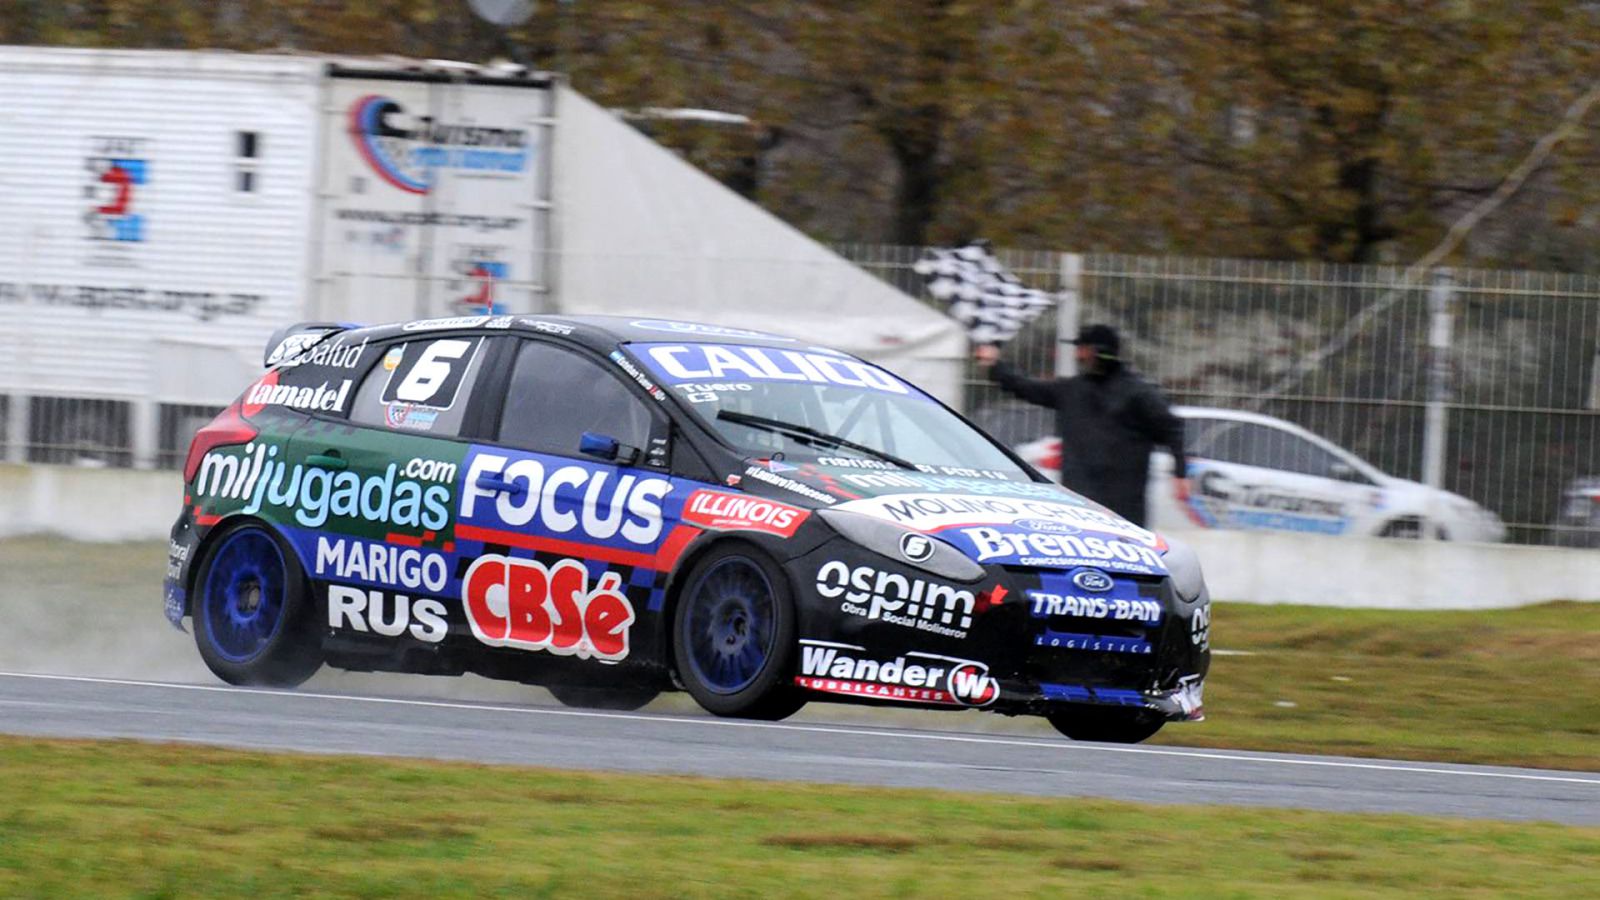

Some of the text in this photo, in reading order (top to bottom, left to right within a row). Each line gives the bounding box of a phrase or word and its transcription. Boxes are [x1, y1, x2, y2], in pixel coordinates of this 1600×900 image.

[397, 339, 471, 402] 6
[648, 345, 908, 395] CALICO
[675, 383, 752, 394] Tuero
[196, 442, 456, 530] miljugadas .com
[460, 454, 675, 545] FOCUS
[690, 492, 800, 529] ILLINOIS
[884, 497, 1014, 521] MOLINO
[315, 537, 449, 592] MARIGO
[904, 534, 927, 556] 6
[961, 526, 1165, 569] Brenson
[328, 585, 449, 644] RUS
[464, 556, 633, 659] CBSé
[841, 602, 968, 640] Obra Social Molineros
[1030, 592, 1161, 622] TRANS-BAN
[802, 646, 944, 689] Wander
[799, 677, 944, 702] LUBRICANTES
